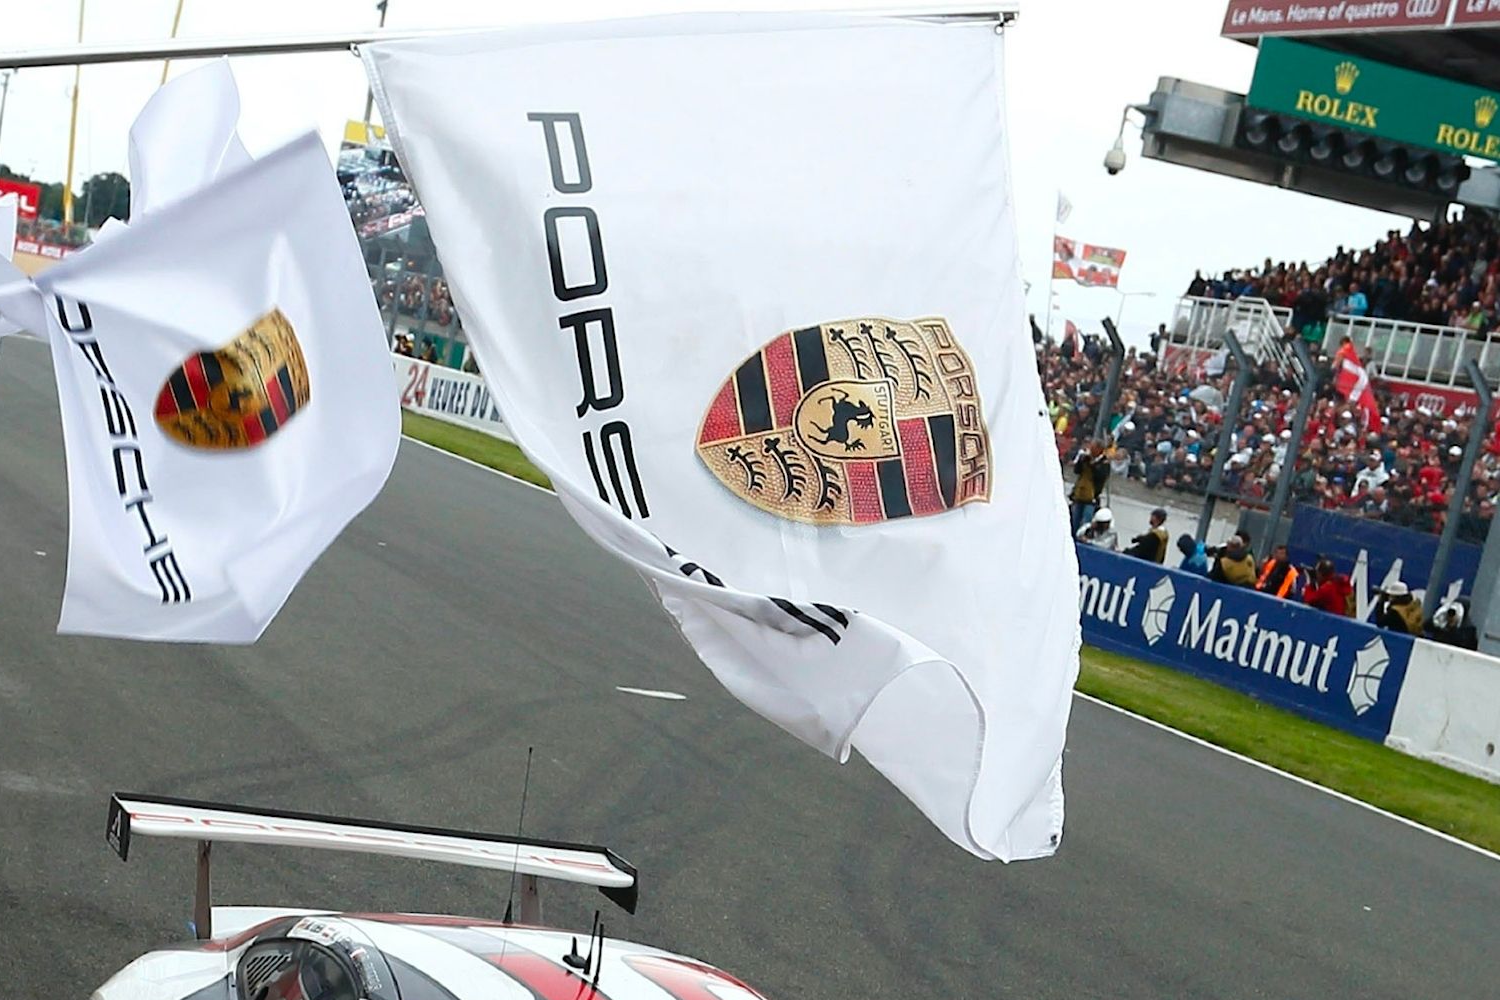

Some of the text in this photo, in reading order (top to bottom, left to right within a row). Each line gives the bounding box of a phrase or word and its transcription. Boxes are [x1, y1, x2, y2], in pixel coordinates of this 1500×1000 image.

[1287, 3, 1326, 21] Home
[1327, 1, 1343, 19] of
[1344, 1, 1398, 22] quattro
[1296, 89, 1379, 128] ROLEX
[1436, 123, 1500, 157] ROLE
[401, 362, 430, 408] 24
[427, 377, 471, 415] HEURES
[922, 324, 986, 499] PORSCHE
[874, 386, 895, 452] STUTTGART
[1177, 592, 1339, 694] Matmut
